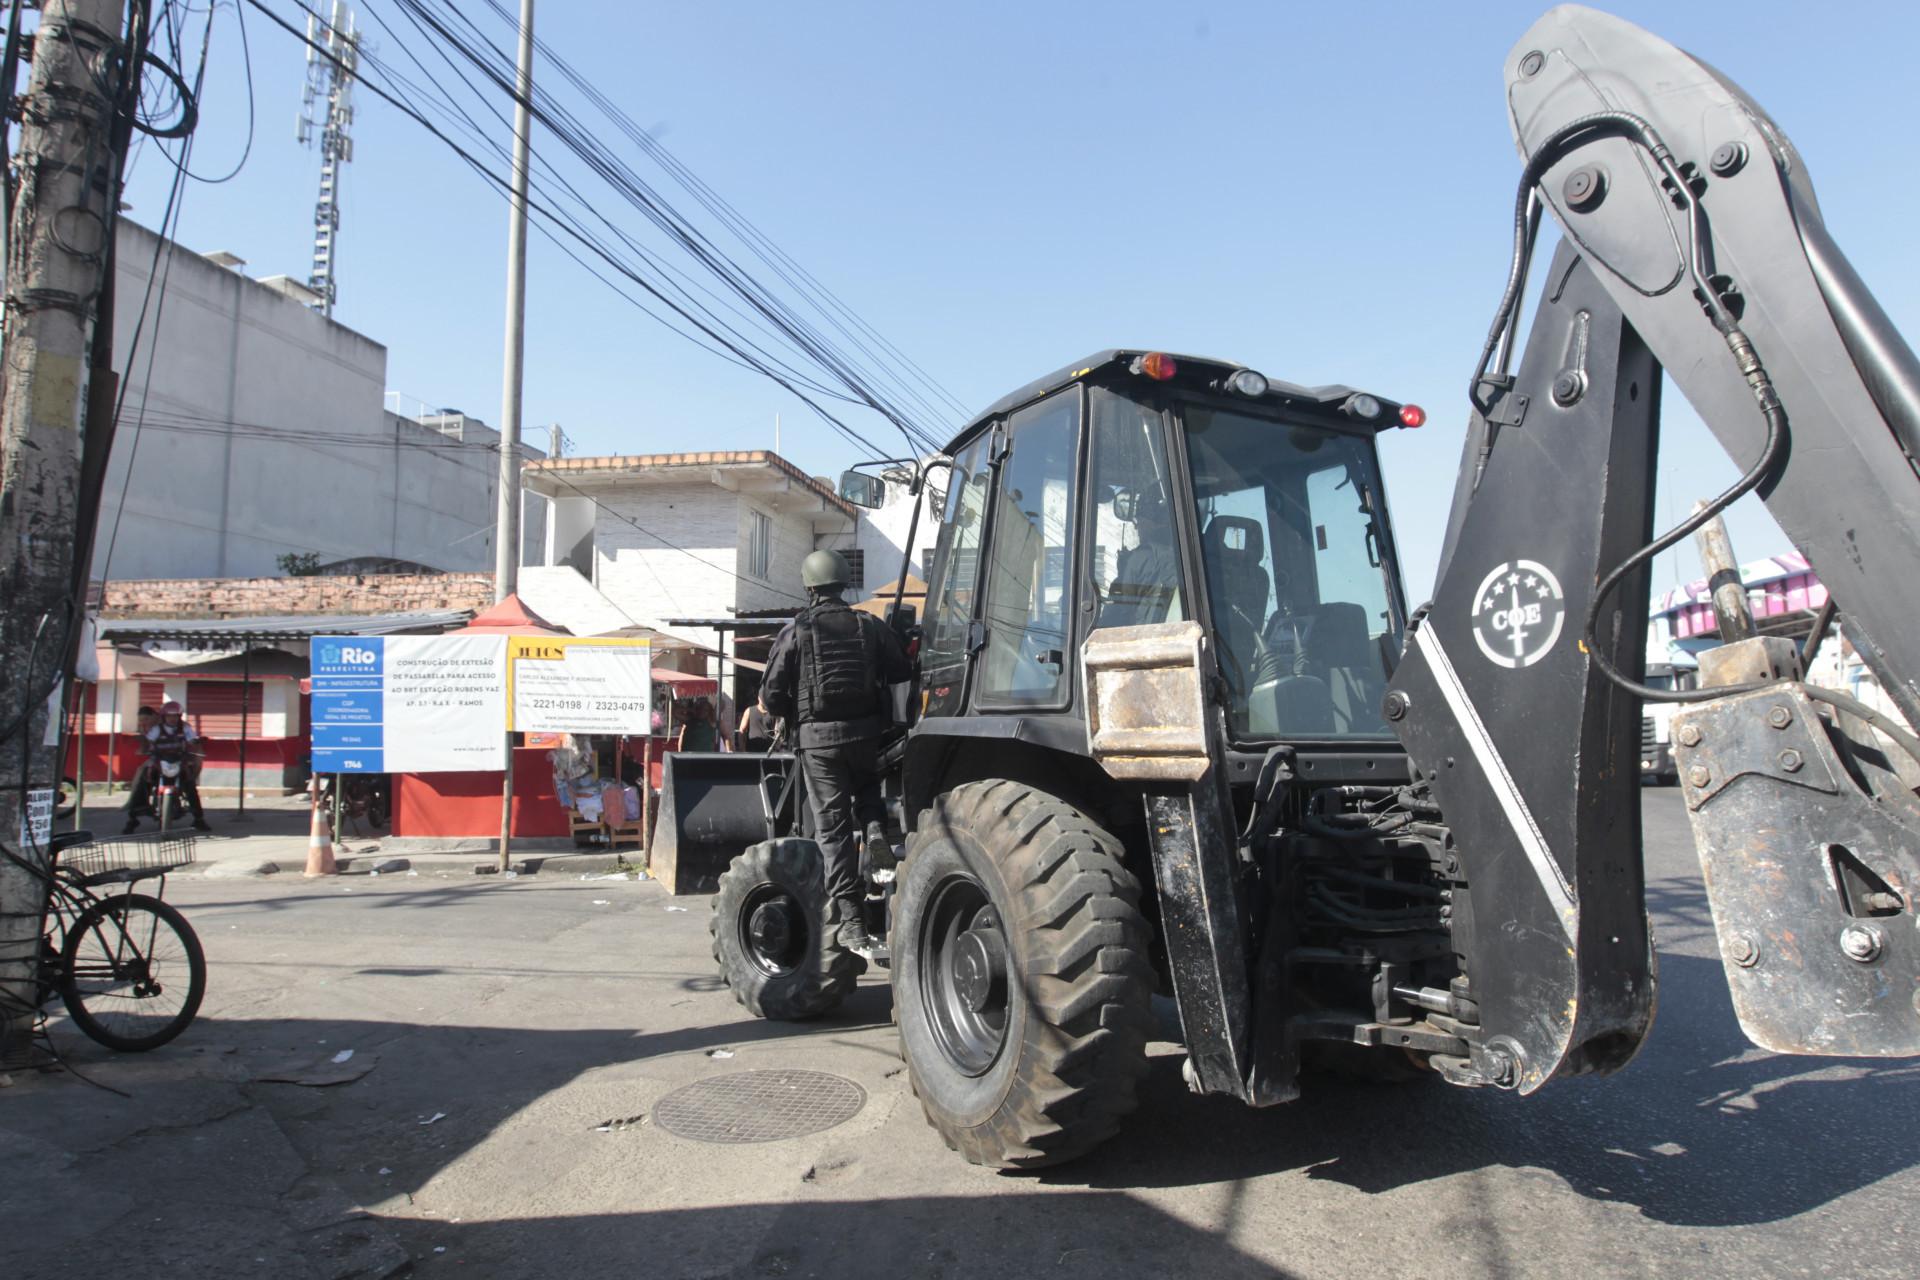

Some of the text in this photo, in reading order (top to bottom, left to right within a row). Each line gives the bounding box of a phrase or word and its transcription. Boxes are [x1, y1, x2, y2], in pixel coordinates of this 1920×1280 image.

[1492, 603, 1542, 631] COE
[341, 647, 376, 665] Rio
[519, 646, 563, 658] JETON
[396, 657, 449, 667] CONSTRUÇÃO
[461, 657, 494, 666] EXTESÃO
[419, 685, 453, 694] ESTAÇÃO
[533, 699, 582, 710] 2221-0198
[595, 701, 645, 711] 2323-0479
[343, 760, 362, 769] 1746
